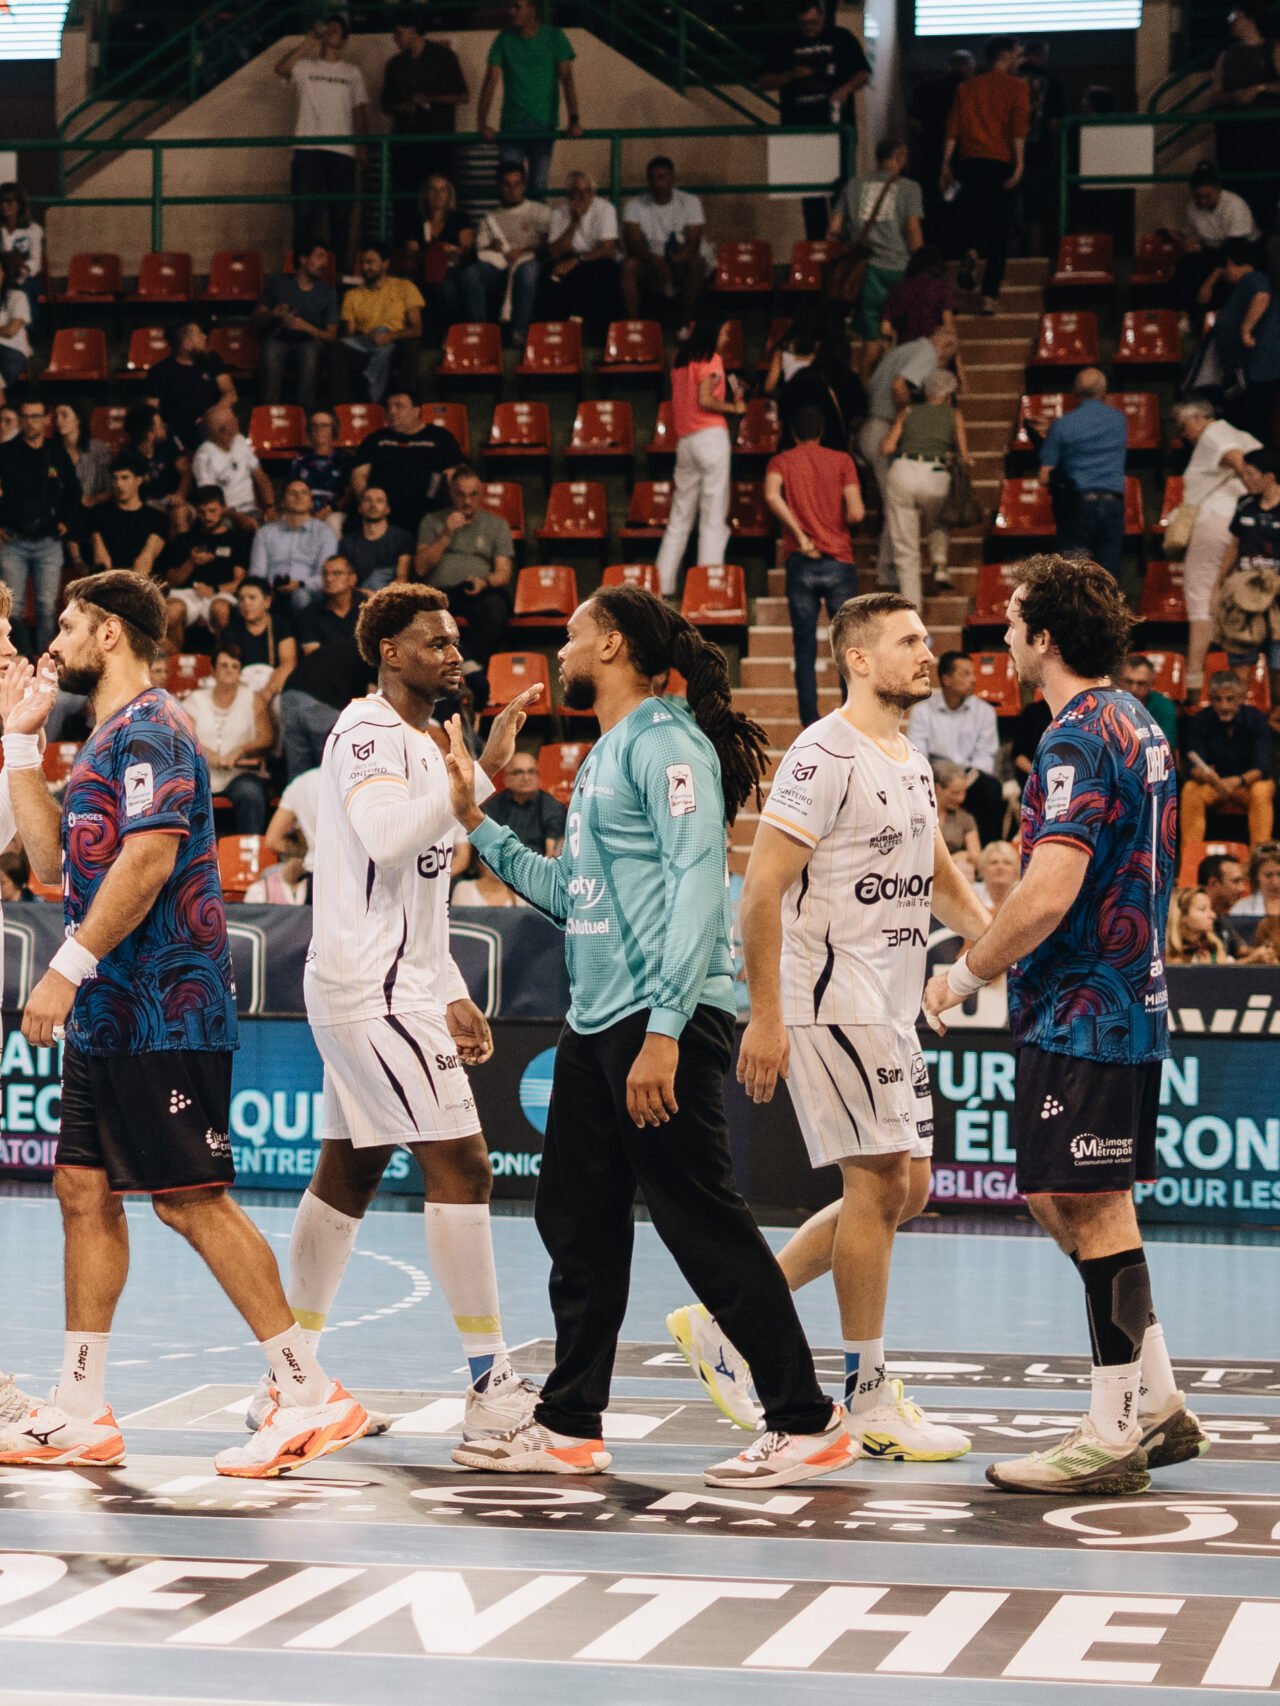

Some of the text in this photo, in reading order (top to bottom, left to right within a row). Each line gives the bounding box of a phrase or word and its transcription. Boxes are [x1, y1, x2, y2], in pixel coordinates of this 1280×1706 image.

[1133, 1176, 1228, 1208] POUR
[77, 1344, 89, 1372] CRAFT
[281, 1346, 301, 1373] CRAFT
[1122, 1391, 1133, 1419] CRAFT
